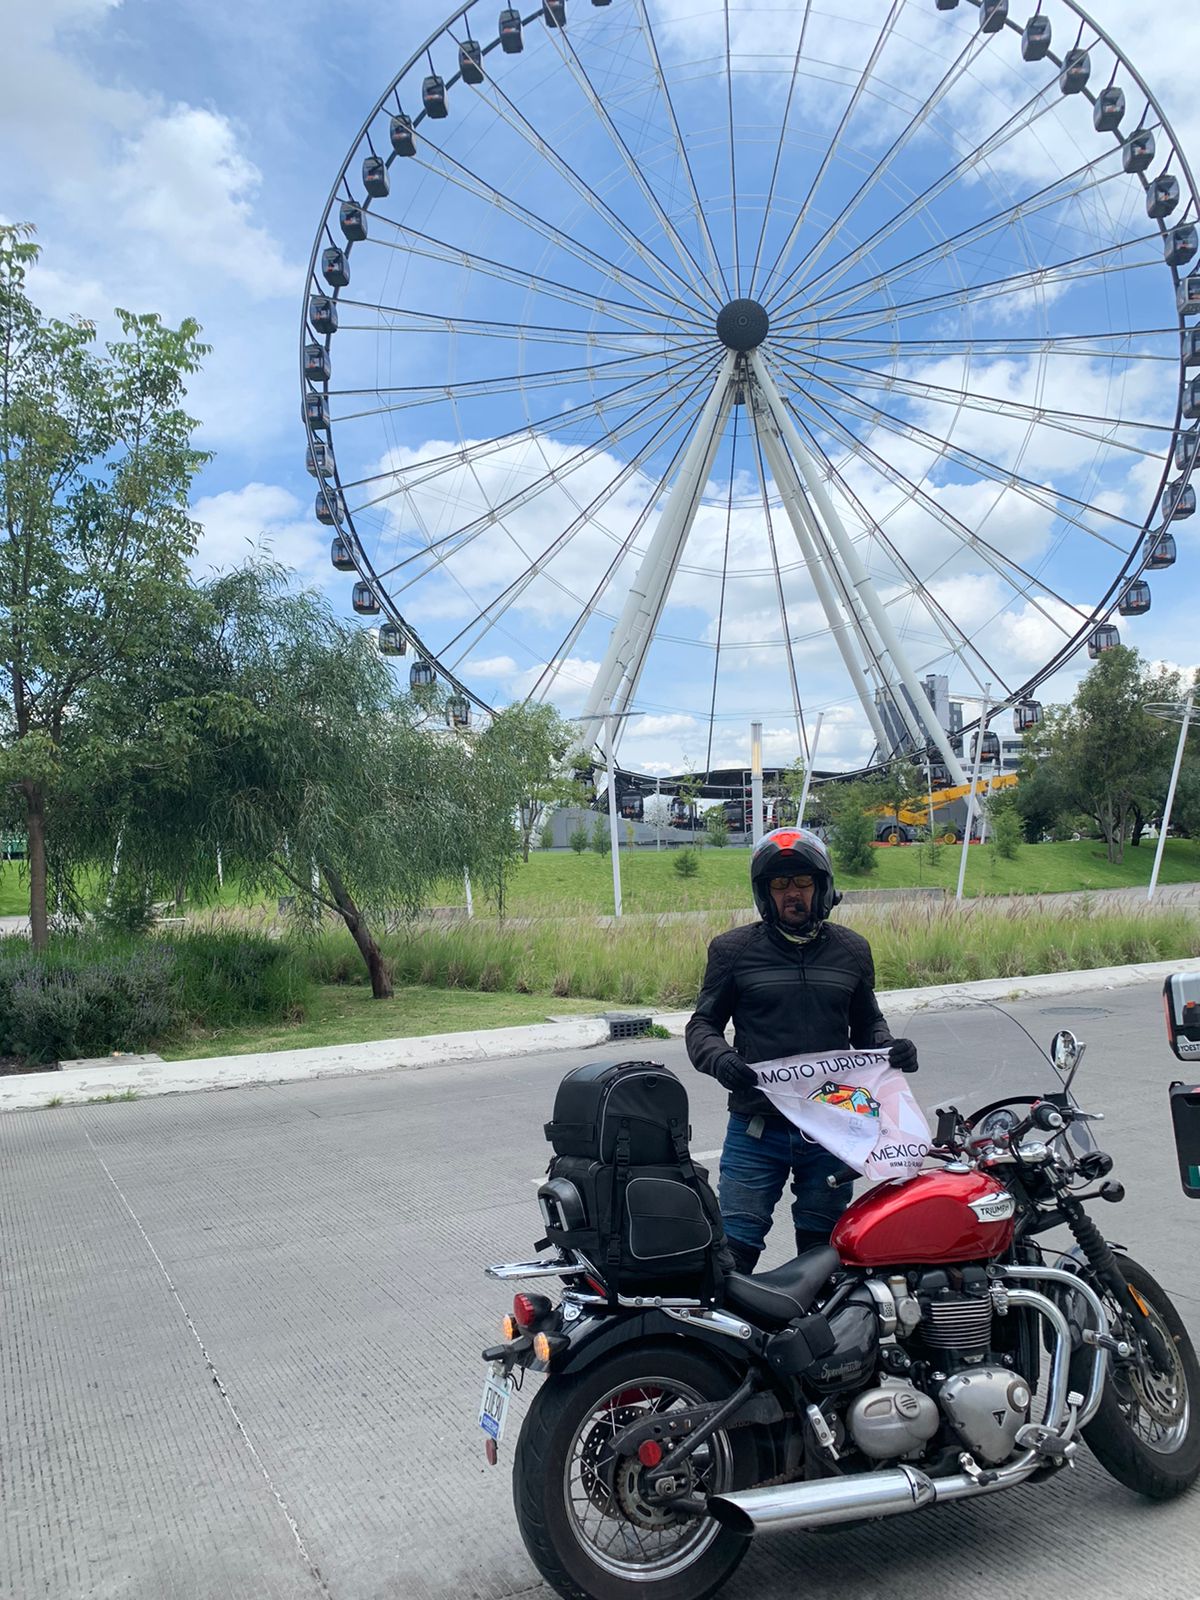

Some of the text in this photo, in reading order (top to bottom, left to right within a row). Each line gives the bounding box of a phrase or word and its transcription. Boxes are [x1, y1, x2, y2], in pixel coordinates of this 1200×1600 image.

[761, 1052, 887, 1084] MOTO TURISTA
[870, 1144, 929, 1162] MÉXICO
[980, 1203, 1010, 1217] TRIUMPH
